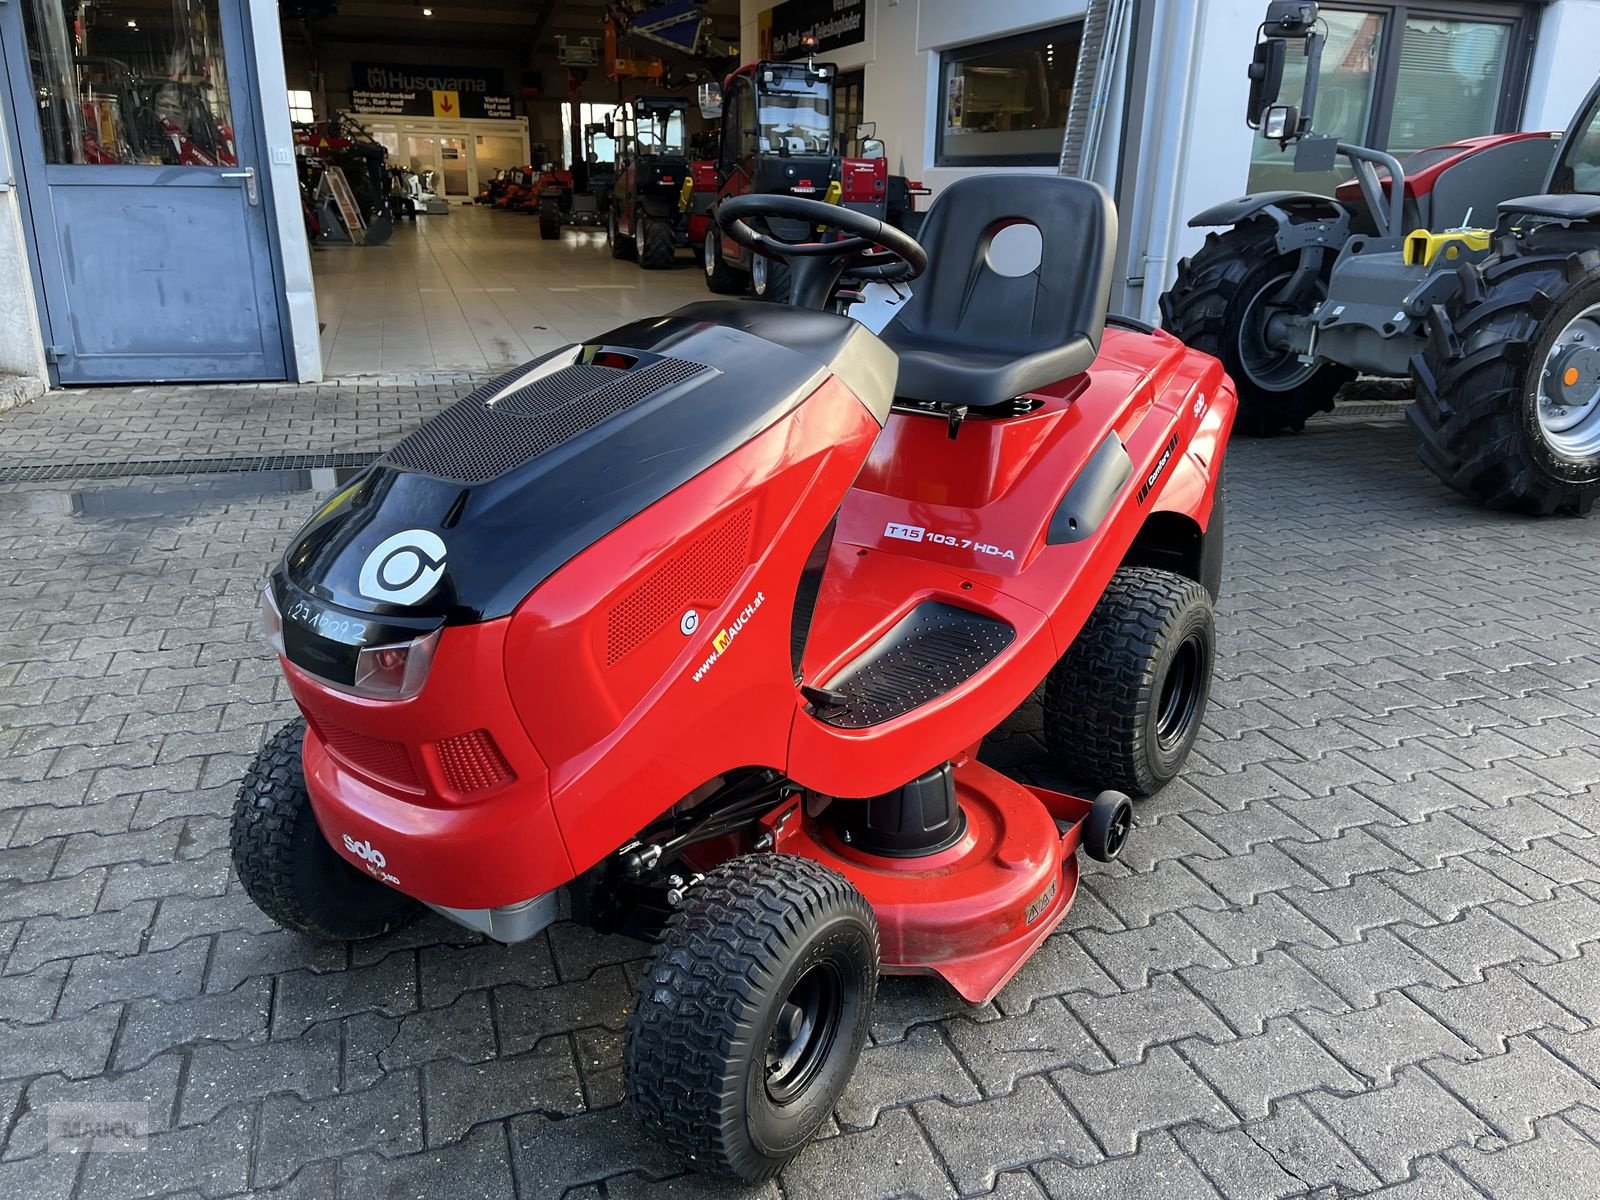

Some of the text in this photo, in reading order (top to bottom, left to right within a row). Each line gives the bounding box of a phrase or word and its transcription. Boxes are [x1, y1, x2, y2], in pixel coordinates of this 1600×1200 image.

[814, 11, 860, 39] Teleskoplader
[353, 90, 415, 100] Gebrauchtverkauf
[389, 73, 486, 92] Husqvarna
[355, 105, 402, 114] Teleskoplader
[1148, 450, 1170, 486] Comfort
[889, 526, 1015, 560] T 15 103.7 HD-A
[692, 591, 765, 683] www.MAUCH.at
[341, 833, 386, 868] solo
